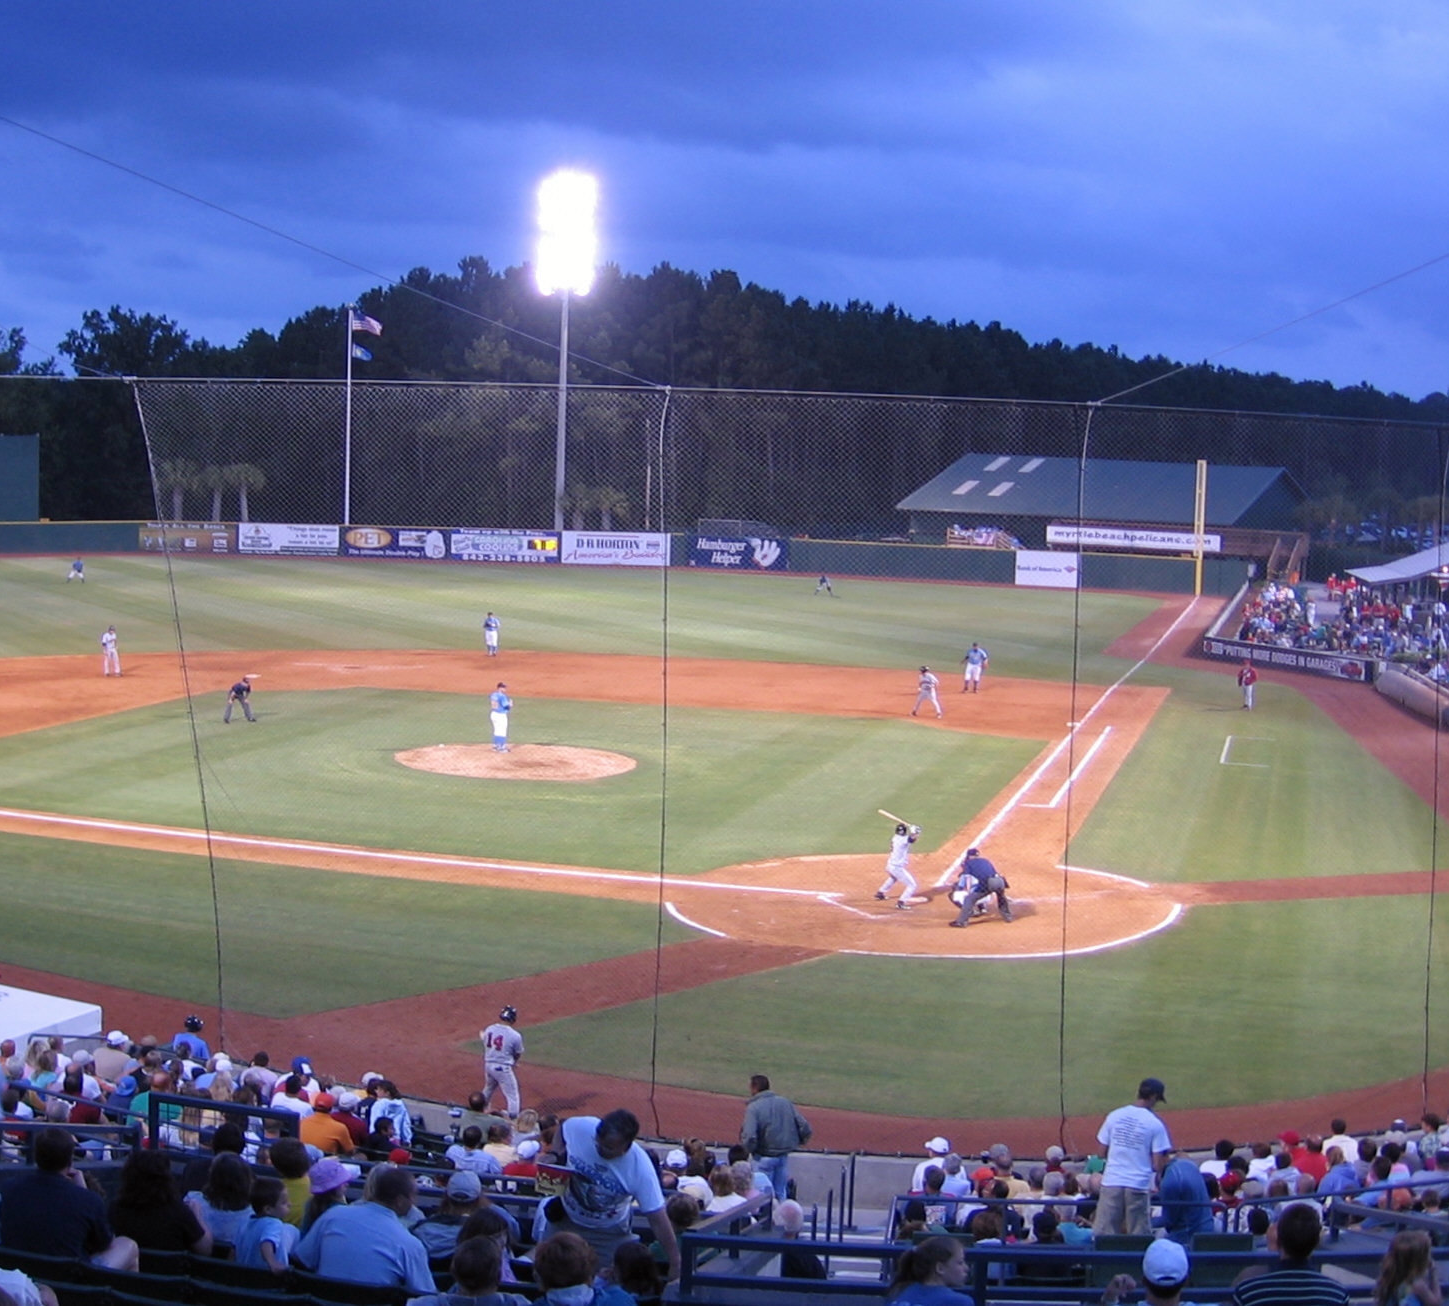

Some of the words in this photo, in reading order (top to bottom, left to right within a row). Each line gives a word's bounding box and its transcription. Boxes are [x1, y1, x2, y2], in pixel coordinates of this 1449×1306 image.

[353, 532, 381, 545] PET
[696, 538, 747, 553] Hamburger
[711, 552, 742, 566] Helper
[1252, 649, 1271, 662] MORE
[1271, 651, 1297, 666] DODGES
[1306, 657, 1336, 672] GARAGES
[487, 1031, 504, 1051] 14
